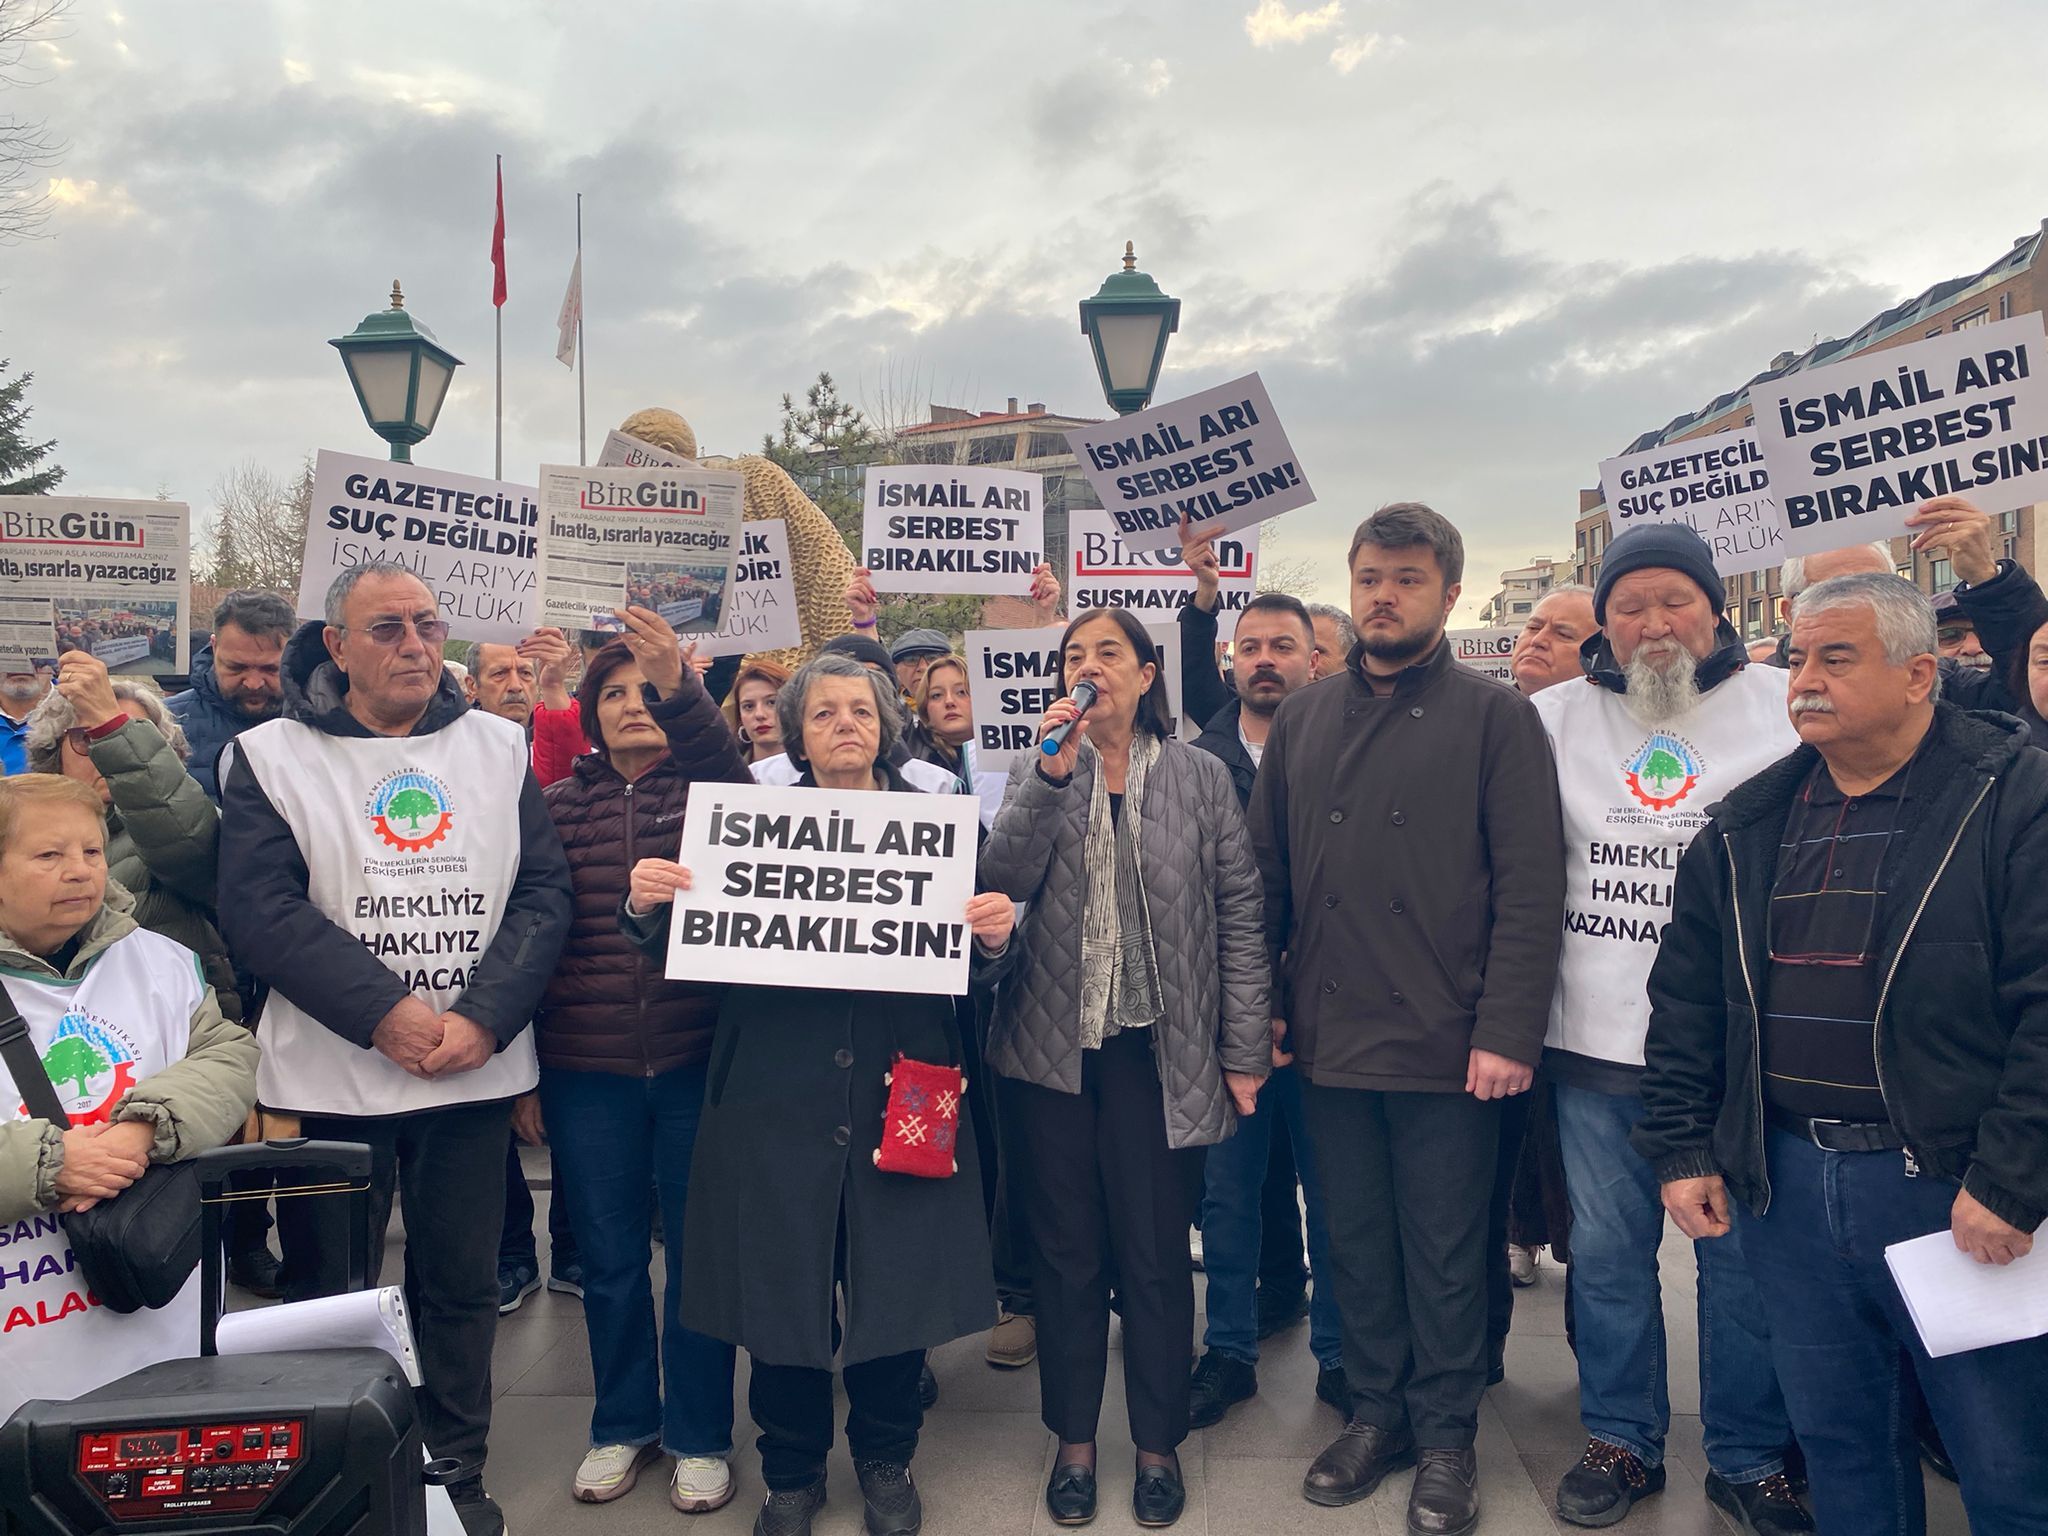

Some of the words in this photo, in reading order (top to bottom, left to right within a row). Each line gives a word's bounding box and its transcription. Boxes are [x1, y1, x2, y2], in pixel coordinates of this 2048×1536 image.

[1779, 366, 1945, 438] İSMAİL
[1955, 344, 2029, 395] ARI
[1085, 422, 1194, 471] İSMAİL
[1199, 399, 1260, 444] ARI
[1810, 396, 2016, 477] SERBEST
[1117, 439, 1255, 500] SERBEST
[1785, 435, 2048, 528] BIRAKILSIN!
[878, 479, 975, 507] İSMAİL
[982, 486, 1030, 512] ARI
[1113, 462, 1300, 533] BIRAKILSIN!
[1618, 492, 1666, 518] SUÇ
[327, 504, 398, 542] SUÇ
[550, 514, 601, 543] İnatla,
[603, 526, 652, 543] ısrarla
[655, 530, 730, 551] yazacağız
[887, 515, 1020, 541] SERBEST
[1702, 526, 1784, 557] RLÜK
[25, 559, 81, 578] ısrarla
[84, 562, 176, 584] yazacağız
[867, 548, 1040, 574] BIRAKILSIN!
[545, 598, 588, 611] Gazetecilik
[1077, 589, 1250, 610] SUSMAYAAK!
[980, 725, 1040, 750] BIR
[708, 803, 865, 853] İSMAİL
[875, 820, 955, 858] ARI
[1605, 814, 1664, 827] ESKİŞEHİR
[363, 864, 425, 878] ESKİŞEHİR
[428, 863, 468, 875] ŞUBESİ
[364, 857, 378, 866] TÜM
[380, 856, 429, 867] EMEKLİLERİN
[1590, 842, 1687, 870] EMEKLİ
[722, 861, 932, 906] SERBEST
[1592, 879, 1672, 908] HAKLI
[354, 887, 486, 919] EMEKLİYİZ
[359, 930, 480, 956] HAKLIYIZ
[681, 909, 964, 959] BIRAKILSIN!
[77, 1100, 92, 1109] 2017
[0, 1212, 62, 1248] SAN
[187, 1499, 211, 1507] SPEAKER
